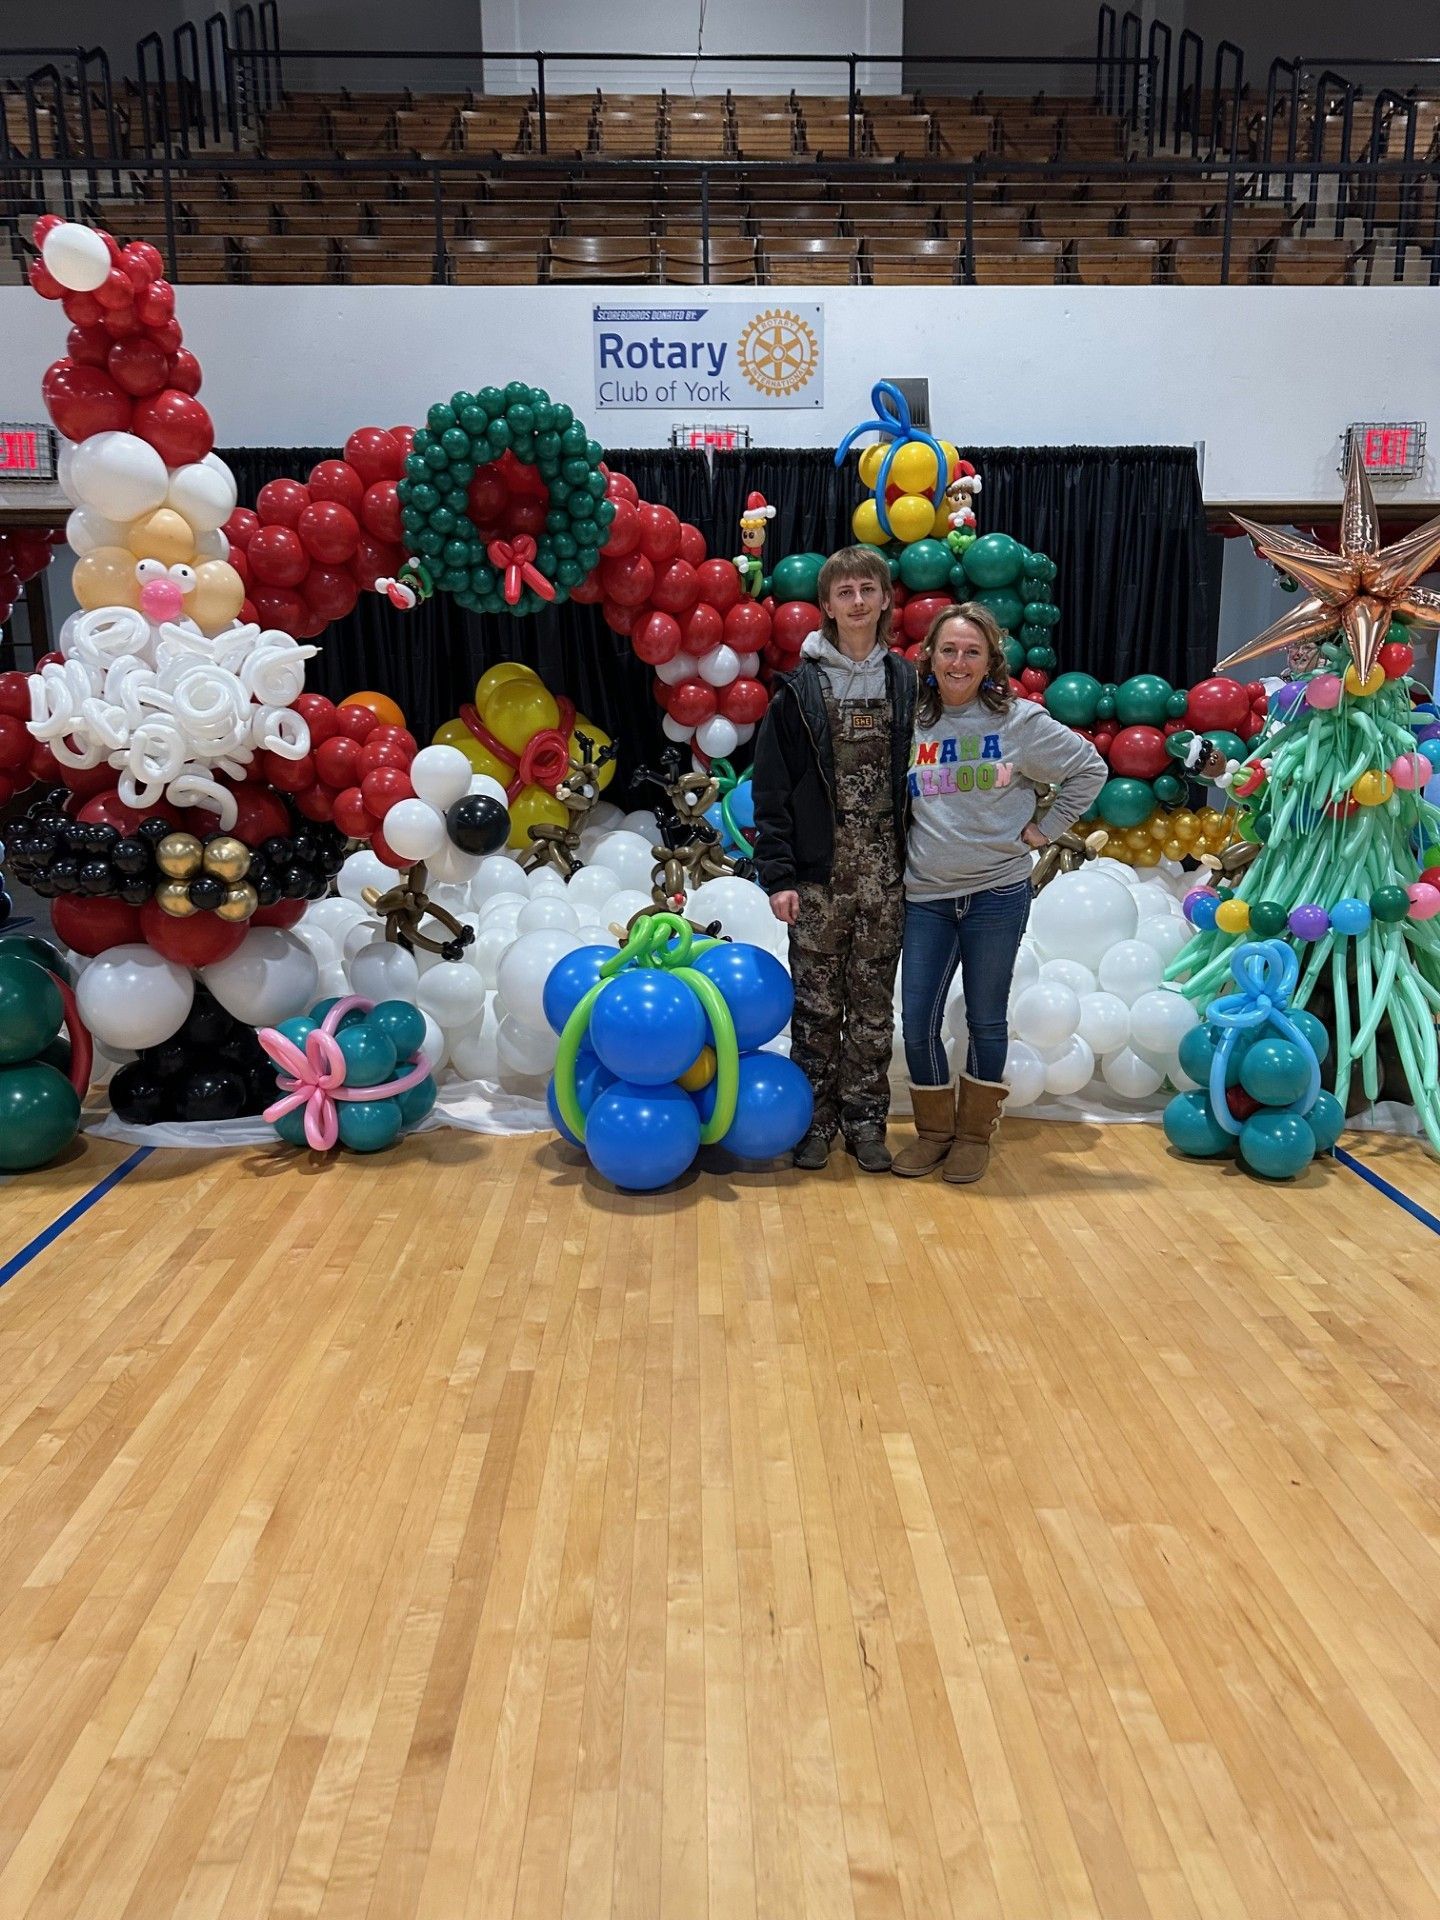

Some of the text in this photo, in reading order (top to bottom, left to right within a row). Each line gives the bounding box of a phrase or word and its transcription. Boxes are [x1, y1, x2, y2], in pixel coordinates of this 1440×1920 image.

[597, 310, 651, 320] SCOREBOARDS
[651, 310, 685, 320] DONATED
[761, 319, 795, 329] ROTARY
[600, 333, 728, 376] Rotary
[751, 366, 807, 387] INTERNATIONAL
[600, 380, 732, 402] Club of York
[1364, 428, 1410, 468] EXIT
[908, 734, 1002, 768] MAHA
